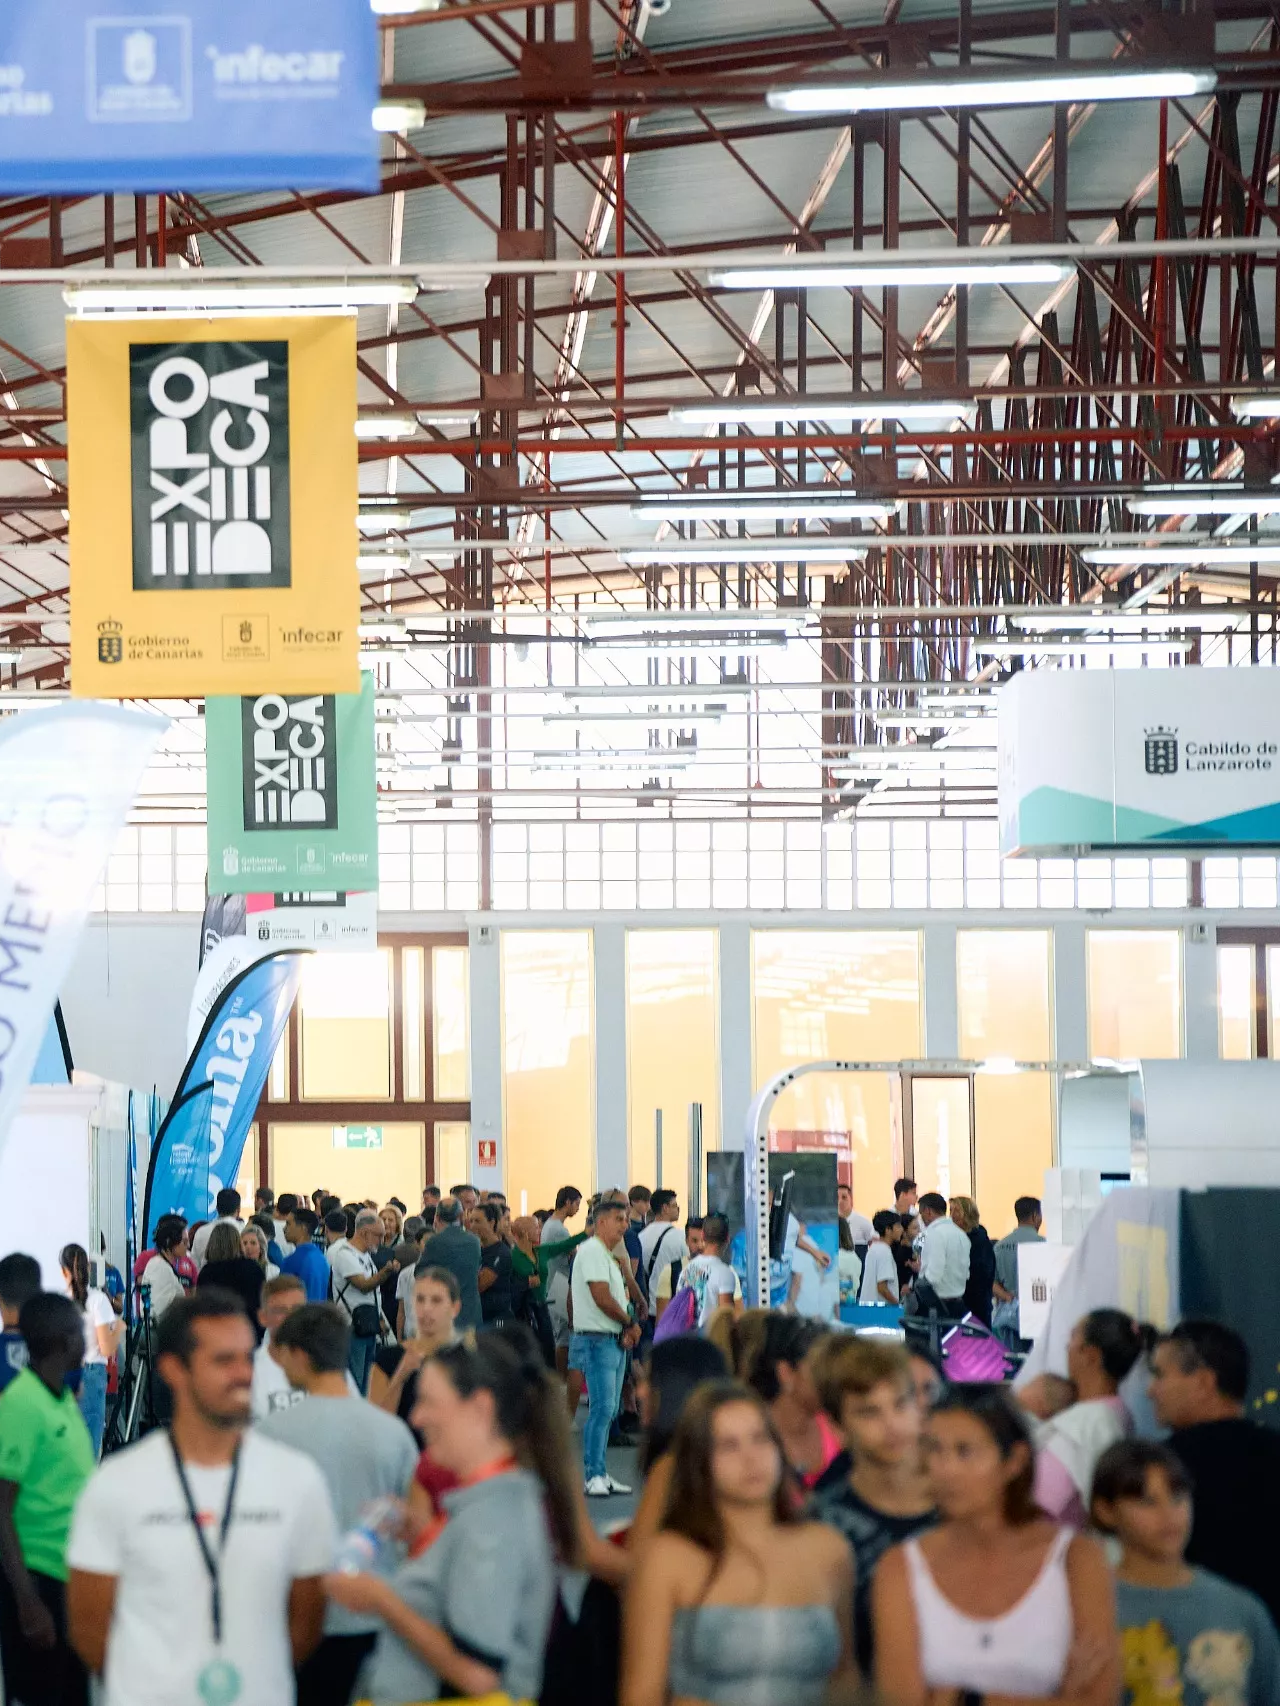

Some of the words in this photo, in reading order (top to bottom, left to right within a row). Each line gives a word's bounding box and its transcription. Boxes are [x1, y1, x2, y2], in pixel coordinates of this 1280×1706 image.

[206, 44, 344, 83] infecar
[148, 356, 211, 576] EXPO
[209, 359, 271, 575] DECA
[128, 635, 190, 647] Gobierno
[279, 627, 344, 645] infecar
[128, 649, 144, 661] de
[146, 649, 204, 661] Canarias
[253, 693, 290, 823] EXPO
[289, 695, 326, 822] DECA
[1185, 741, 1251, 756] Cabildo
[1256, 741, 1278, 755] de
[1185, 757, 1272, 771] Lanzarote
